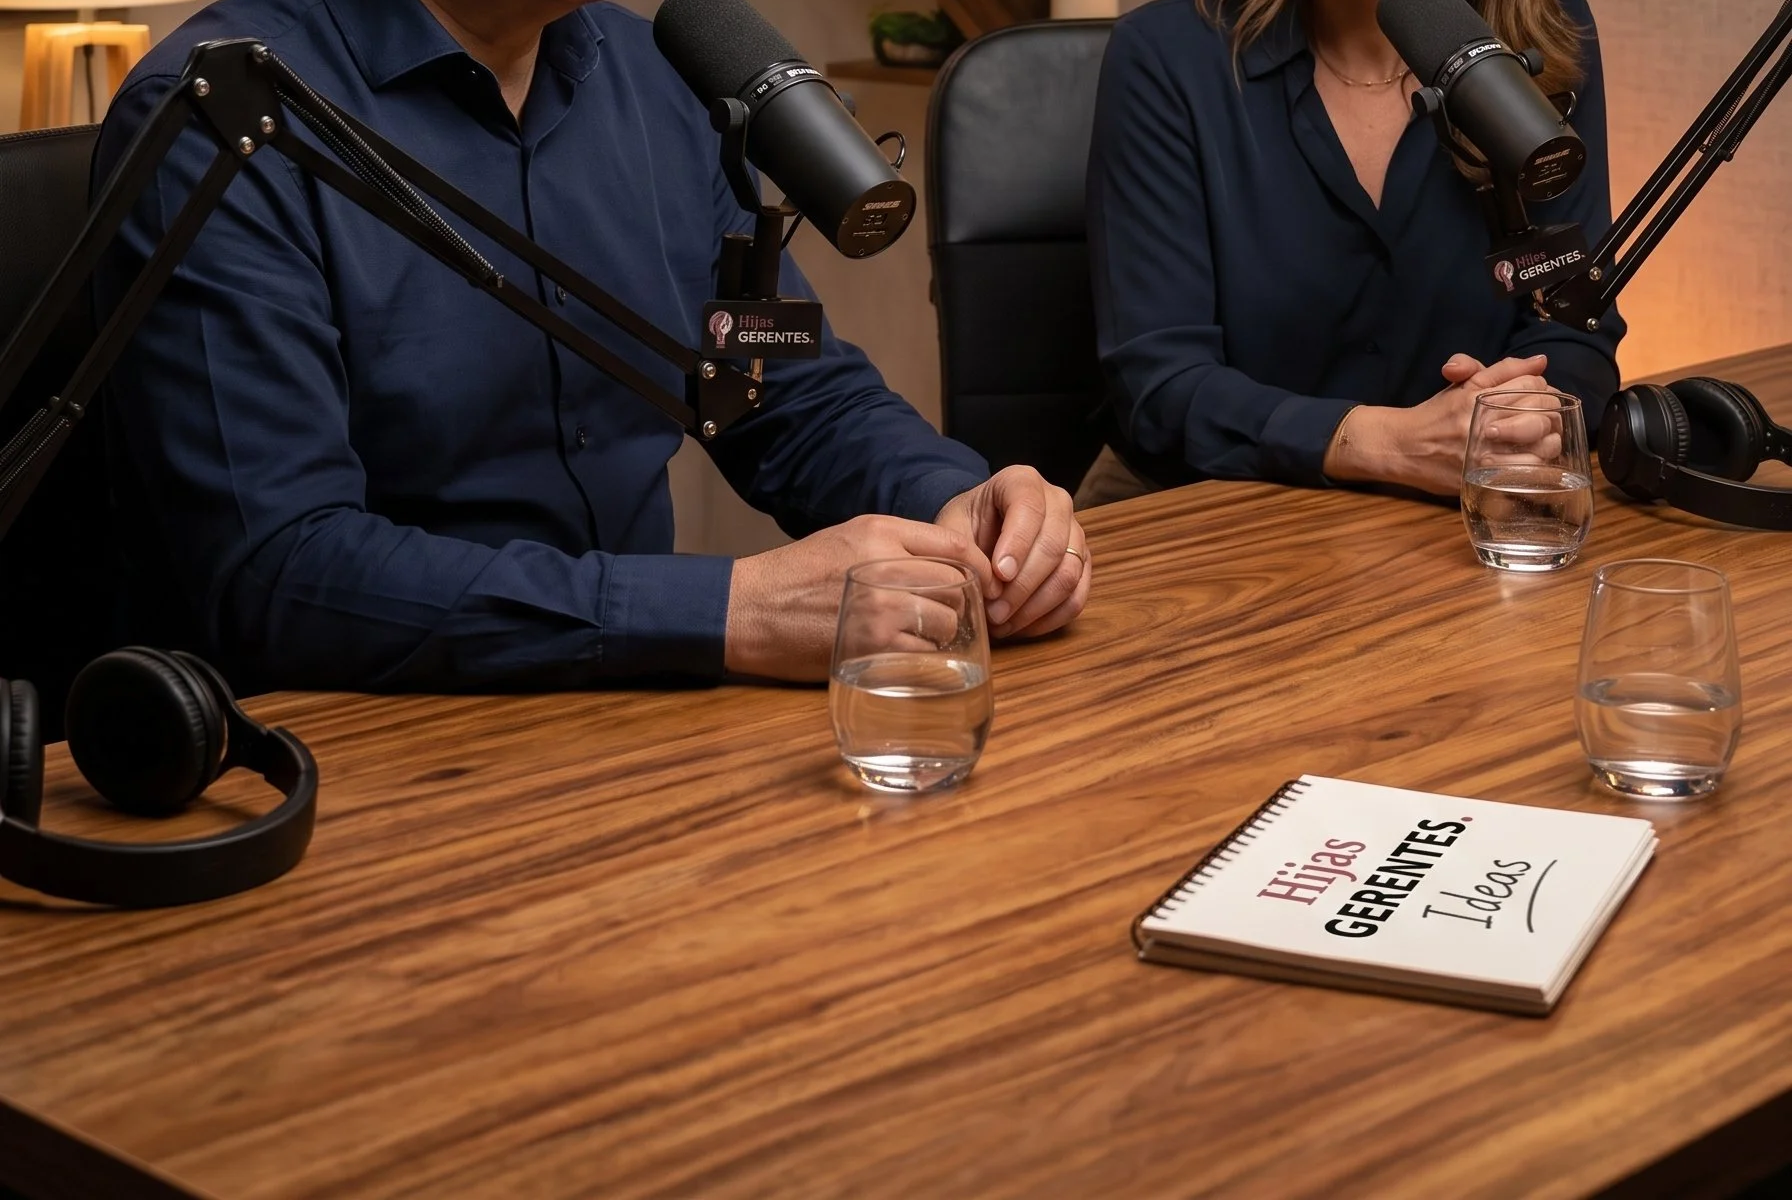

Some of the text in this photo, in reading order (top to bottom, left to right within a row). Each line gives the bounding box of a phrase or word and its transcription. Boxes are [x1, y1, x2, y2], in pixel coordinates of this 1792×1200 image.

[738, 315, 774, 330] Hijas
[738, 331, 814, 344] GERENTES.
[1256, 839, 1366, 905] Hijas
[1324, 816, 1473, 938] GERENTES.
[1422, 860, 1532, 929] Ideas
